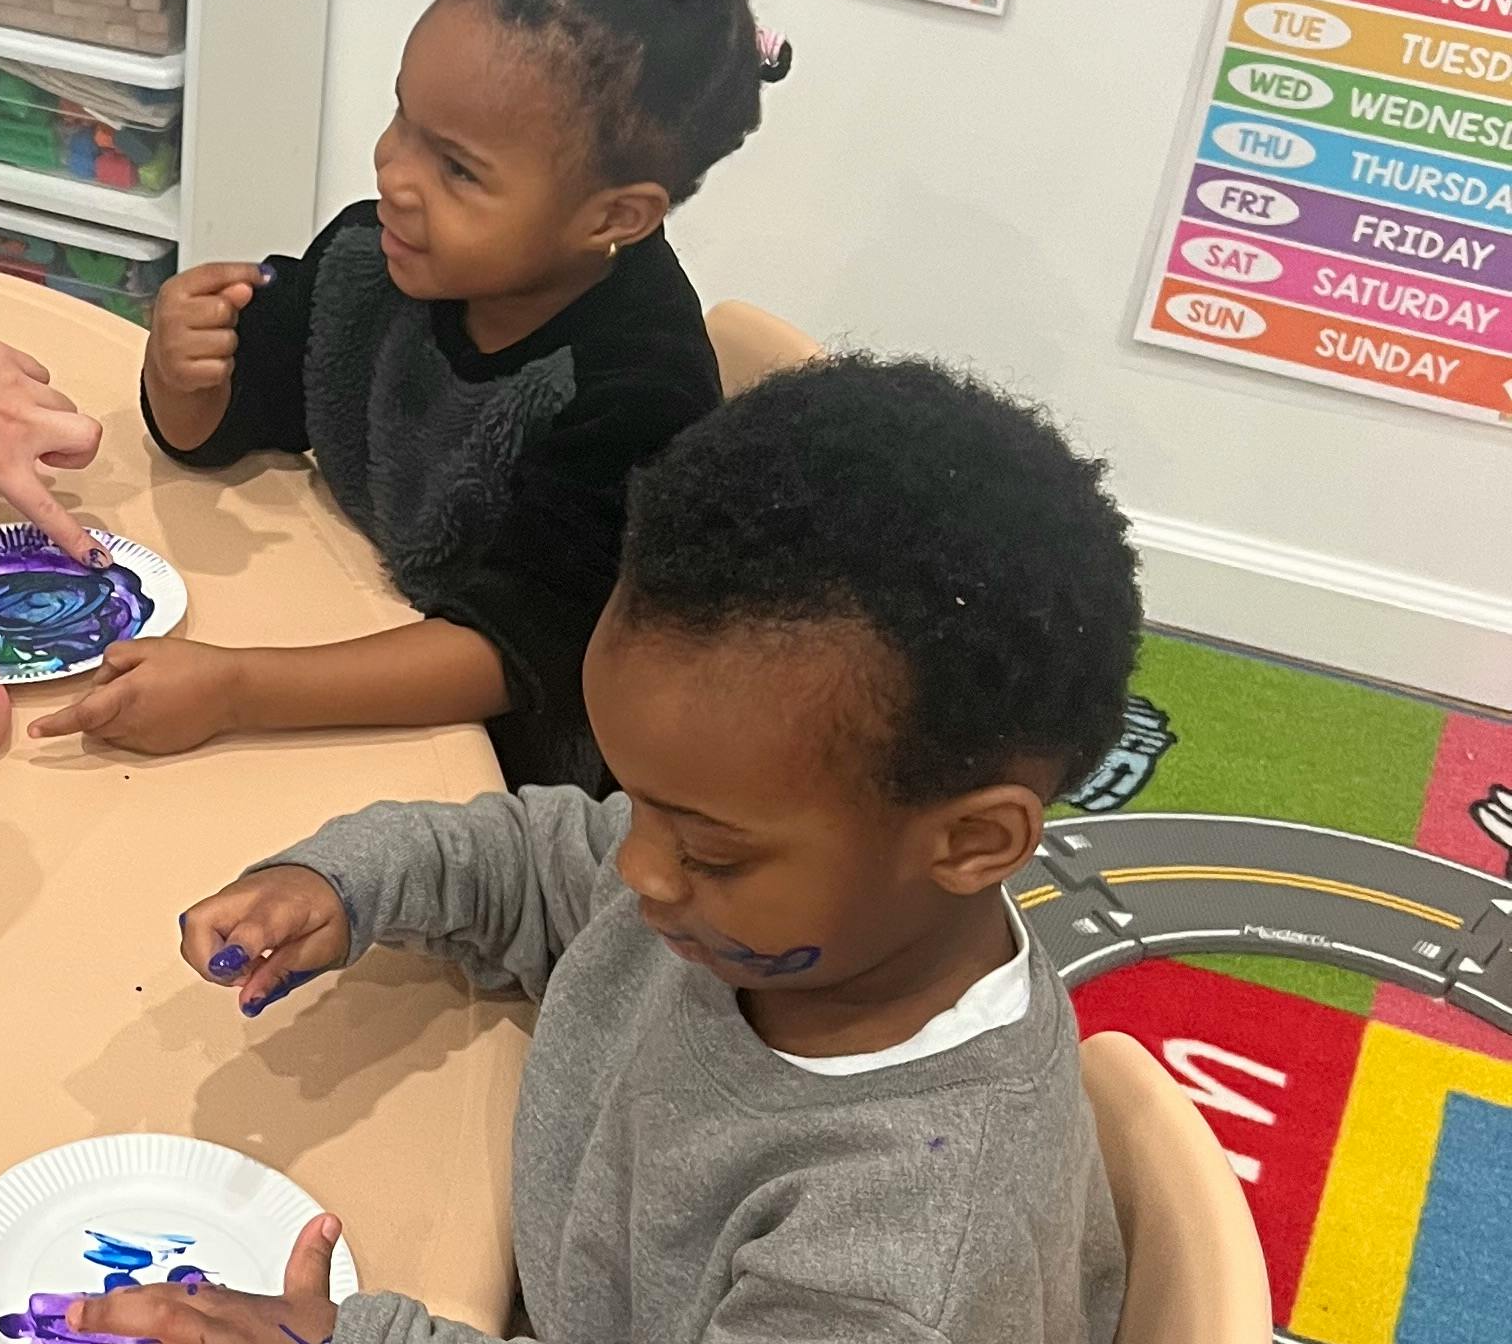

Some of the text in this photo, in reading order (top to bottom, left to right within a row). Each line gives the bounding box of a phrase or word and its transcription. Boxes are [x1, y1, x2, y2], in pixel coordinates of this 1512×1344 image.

[1272, 9, 1327, 43] TUE
[1249, 68, 1313, 103] WED
[1238, 128, 1293, 161] THU
[1220, 186, 1496, 271] FRI FRIDAY
[1204, 244, 1500, 334] SAT SATURDAY
[1187, 299, 1461, 385] SUN SUNDAY
